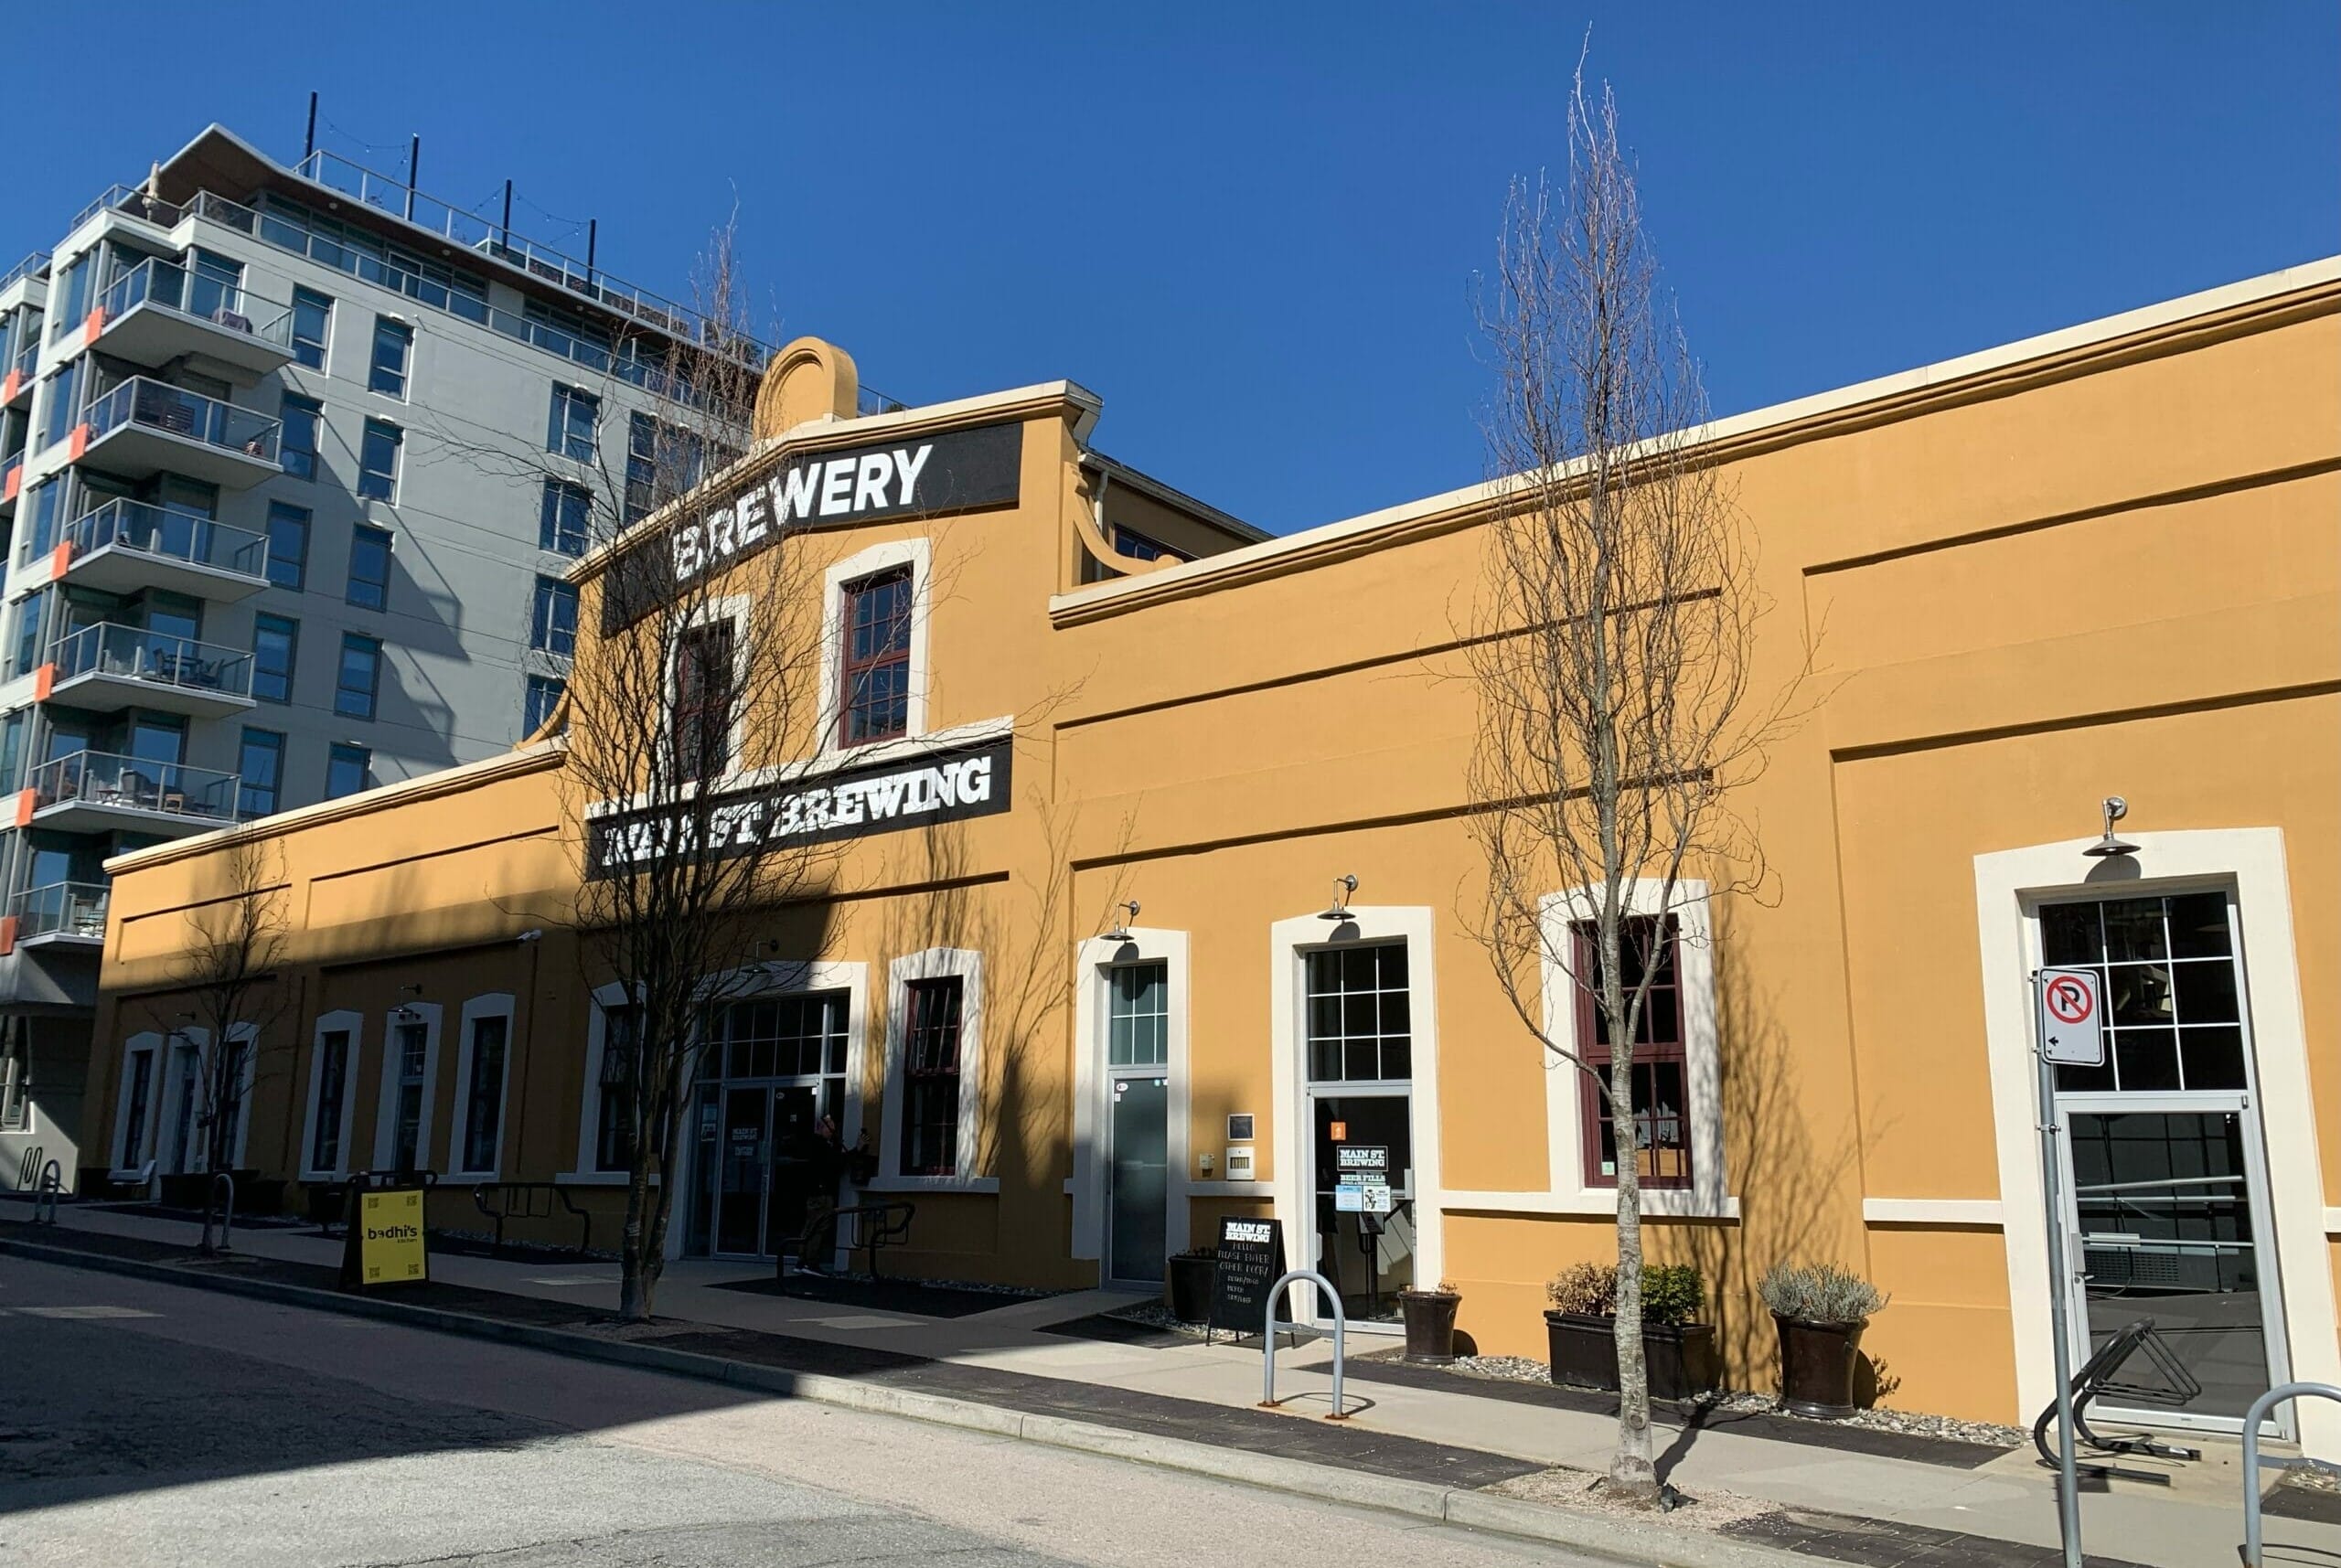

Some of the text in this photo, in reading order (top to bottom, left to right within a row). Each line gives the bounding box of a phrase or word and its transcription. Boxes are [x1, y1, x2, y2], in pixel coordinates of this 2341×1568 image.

[672, 444, 933, 582] BREWERY
[768, 755, 991, 838] BREWING
[1340, 1149, 1369, 1158] MAIN
[1340, 1158, 1385, 1167] BREWING
[1226, 1222, 1256, 1233] MAIN
[1224, 1232, 1270, 1243] BREWING
